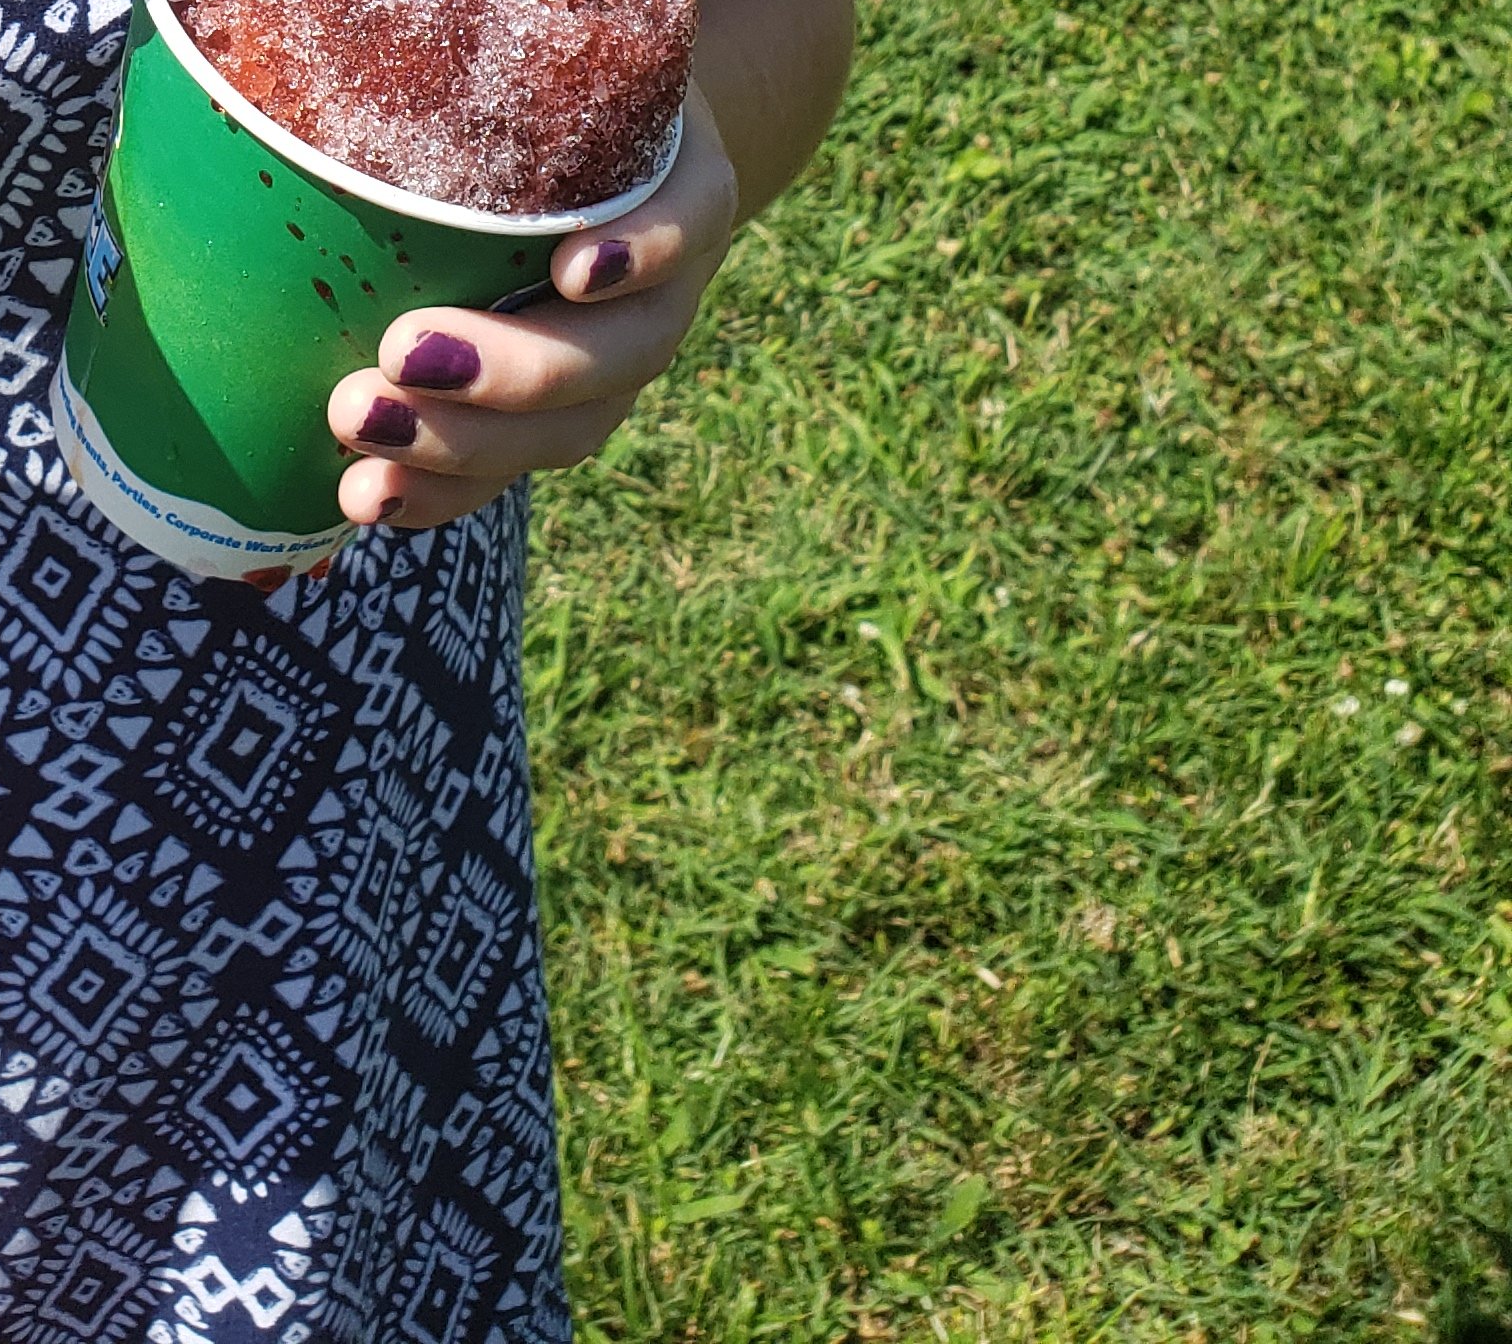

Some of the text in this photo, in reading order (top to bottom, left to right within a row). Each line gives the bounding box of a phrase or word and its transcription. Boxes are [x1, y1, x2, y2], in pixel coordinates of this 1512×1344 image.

[111, 470, 162, 519] Parties,
[165, 512, 241, 549] Corporate
[245, 540, 286, 553] Work
